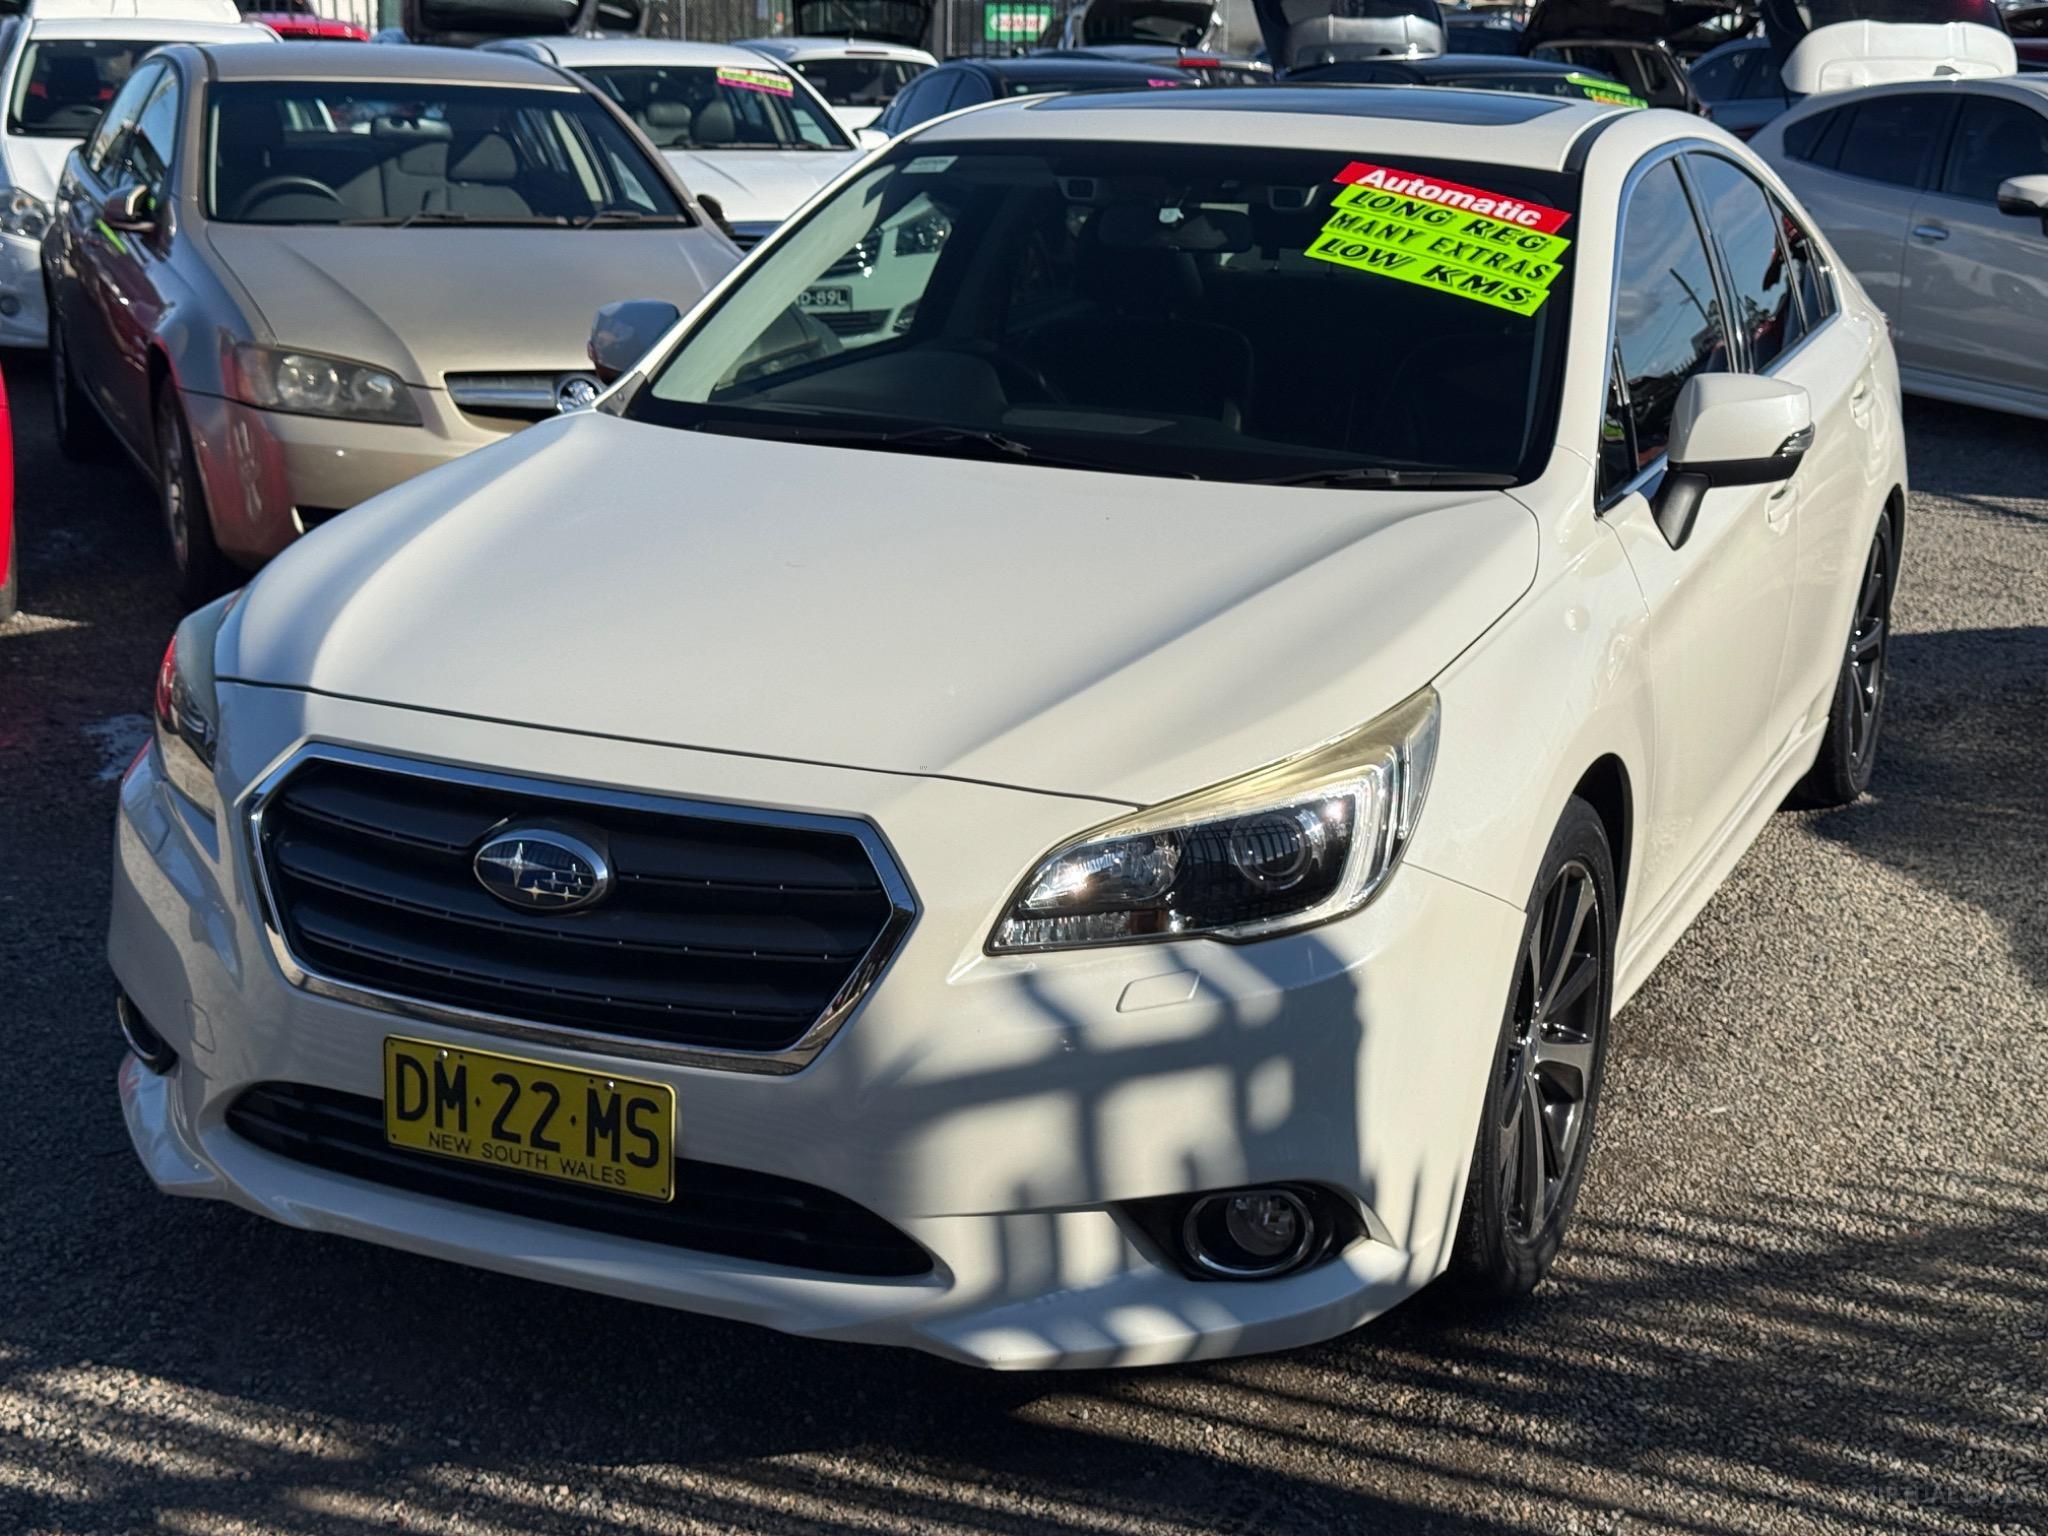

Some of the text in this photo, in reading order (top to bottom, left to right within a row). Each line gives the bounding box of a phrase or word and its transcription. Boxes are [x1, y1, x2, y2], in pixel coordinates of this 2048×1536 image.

[1346, 190, 1551, 252] LONG REG
[1356, 169, 1542, 226] Automatic
[1315, 238, 1537, 305] LOW KMS
[1329, 213, 1553, 280] MANY EXTRAS
[428, 1131, 627, 1186] NEW SOUTH WALES
